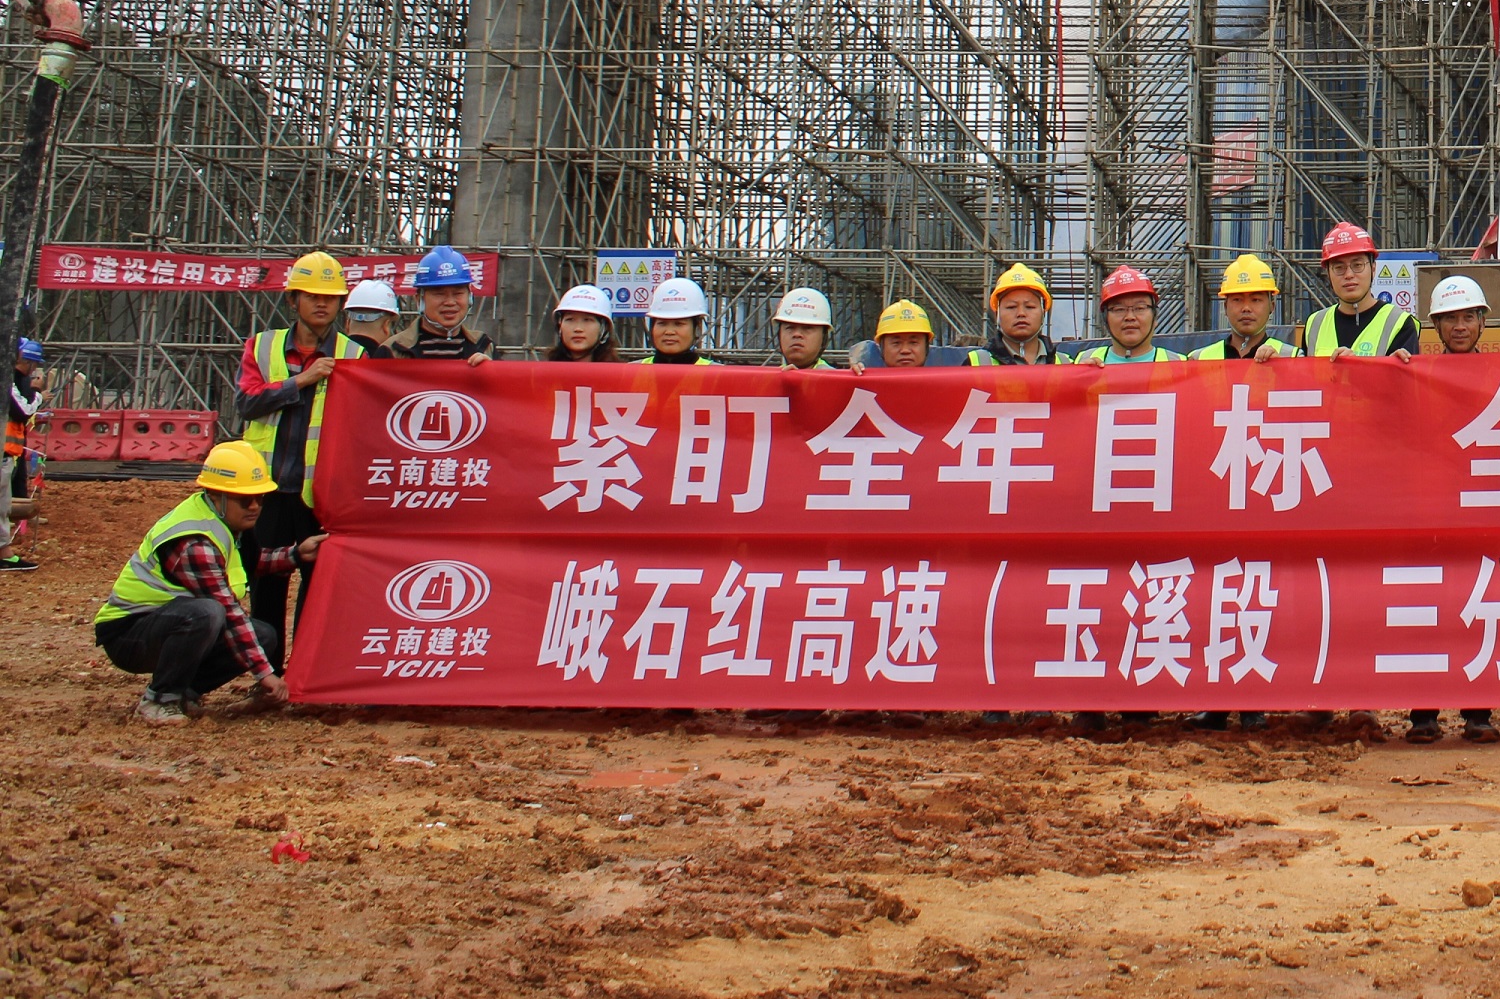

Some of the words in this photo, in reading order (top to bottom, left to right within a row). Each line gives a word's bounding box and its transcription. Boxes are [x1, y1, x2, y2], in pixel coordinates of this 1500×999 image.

[538, 384, 1333, 515] 紧盯全年目标
[366, 456, 492, 487] 云南建投
[389, 491, 460, 509] YCIH
[361, 626, 491, 656] 云南建投
[381, 660, 456, 678] YCIH
